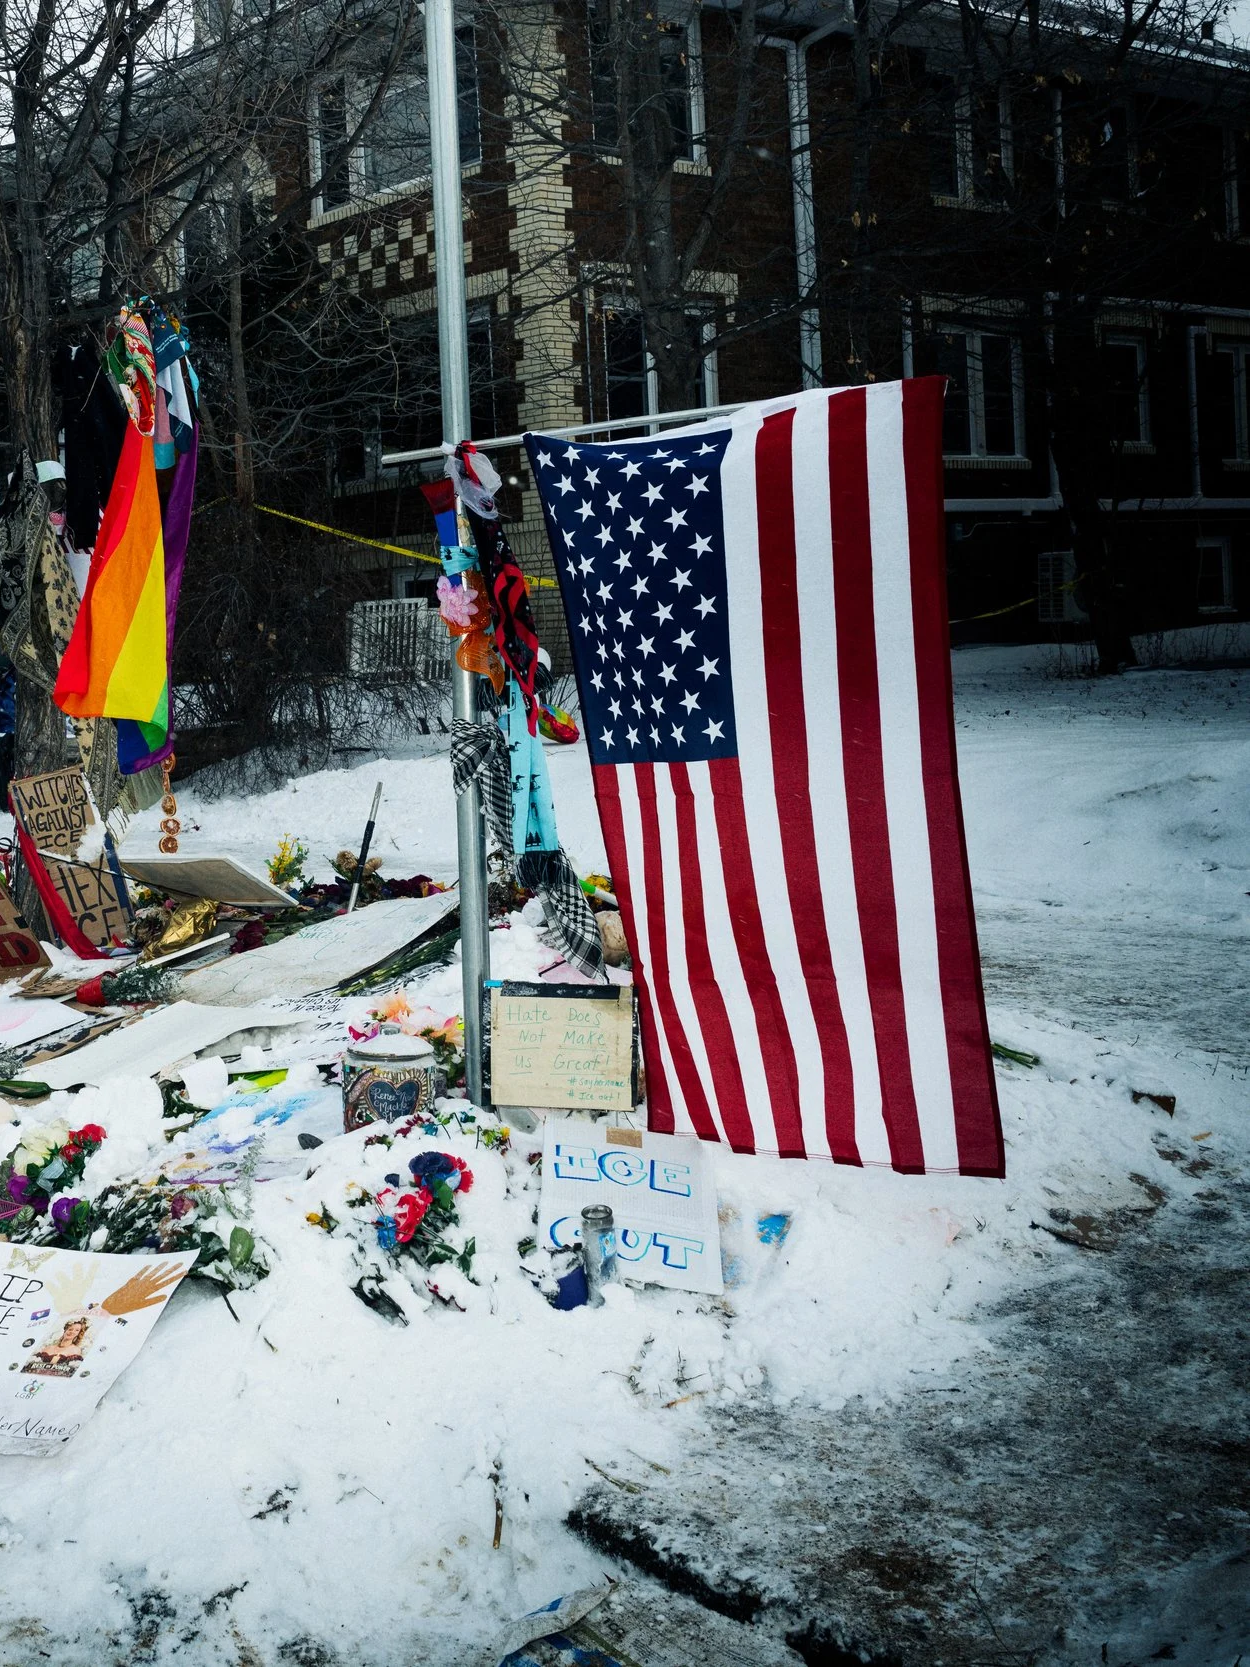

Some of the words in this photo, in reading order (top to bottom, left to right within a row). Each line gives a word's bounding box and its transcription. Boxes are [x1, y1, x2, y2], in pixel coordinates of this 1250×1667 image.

[19, 774, 88, 810] WITCHES
[28, 801, 88, 836] AGAINST
[37, 829, 82, 849] ICE
[48, 855, 117, 913] HEX
[71, 906, 119, 948] CE
[506, 1004, 551, 1021] Hate
[568, 1007, 602, 1025] Does
[519, 1028, 546, 1043] Not
[562, 1030, 605, 1045] Make
[554, 1144, 692, 1198] ICE
